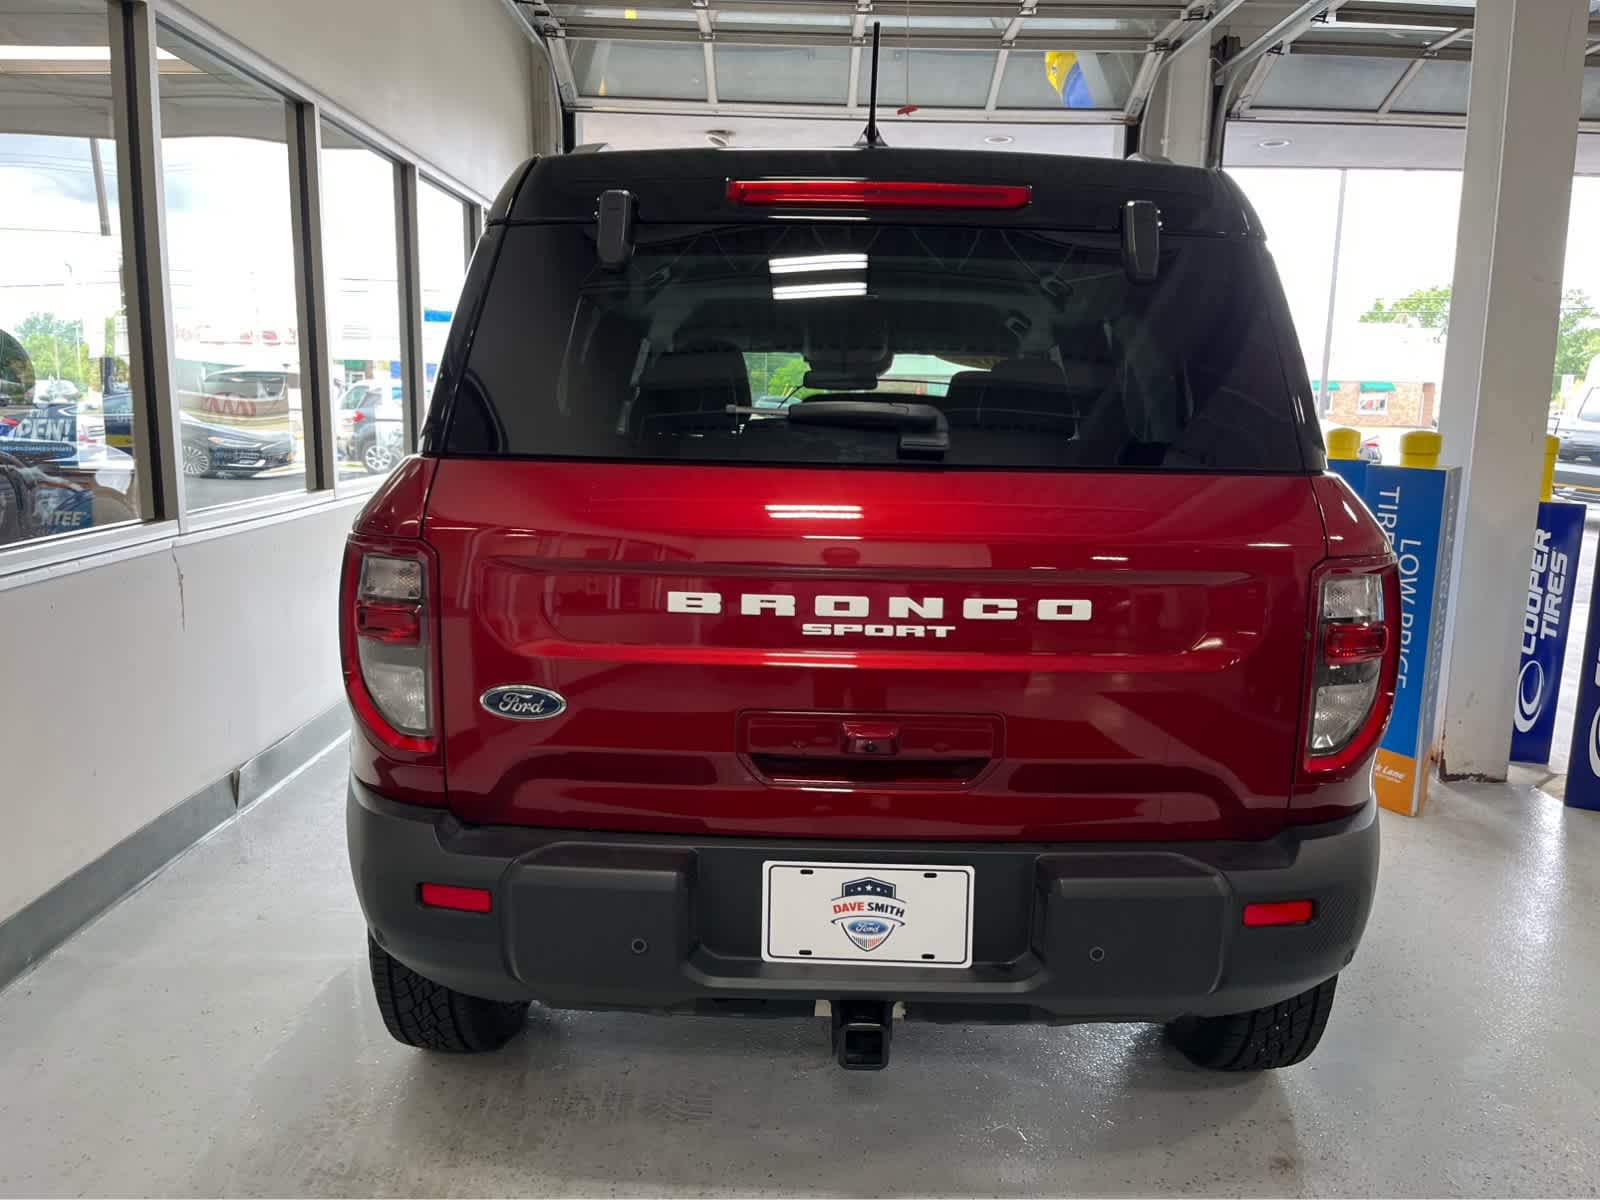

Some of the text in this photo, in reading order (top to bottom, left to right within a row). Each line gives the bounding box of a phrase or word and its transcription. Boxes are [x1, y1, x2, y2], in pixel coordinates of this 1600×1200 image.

[1399, 539, 1421, 605] LOW
[667, 591, 1092, 621] BRONCO
[1521, 528, 1552, 655] COOPER
[1540, 549, 1568, 640] TIRES
[802, 623, 956, 638] SPORT
[499, 692, 544, 713] Ford
[833, 902, 905, 917] DAVE SMITH
